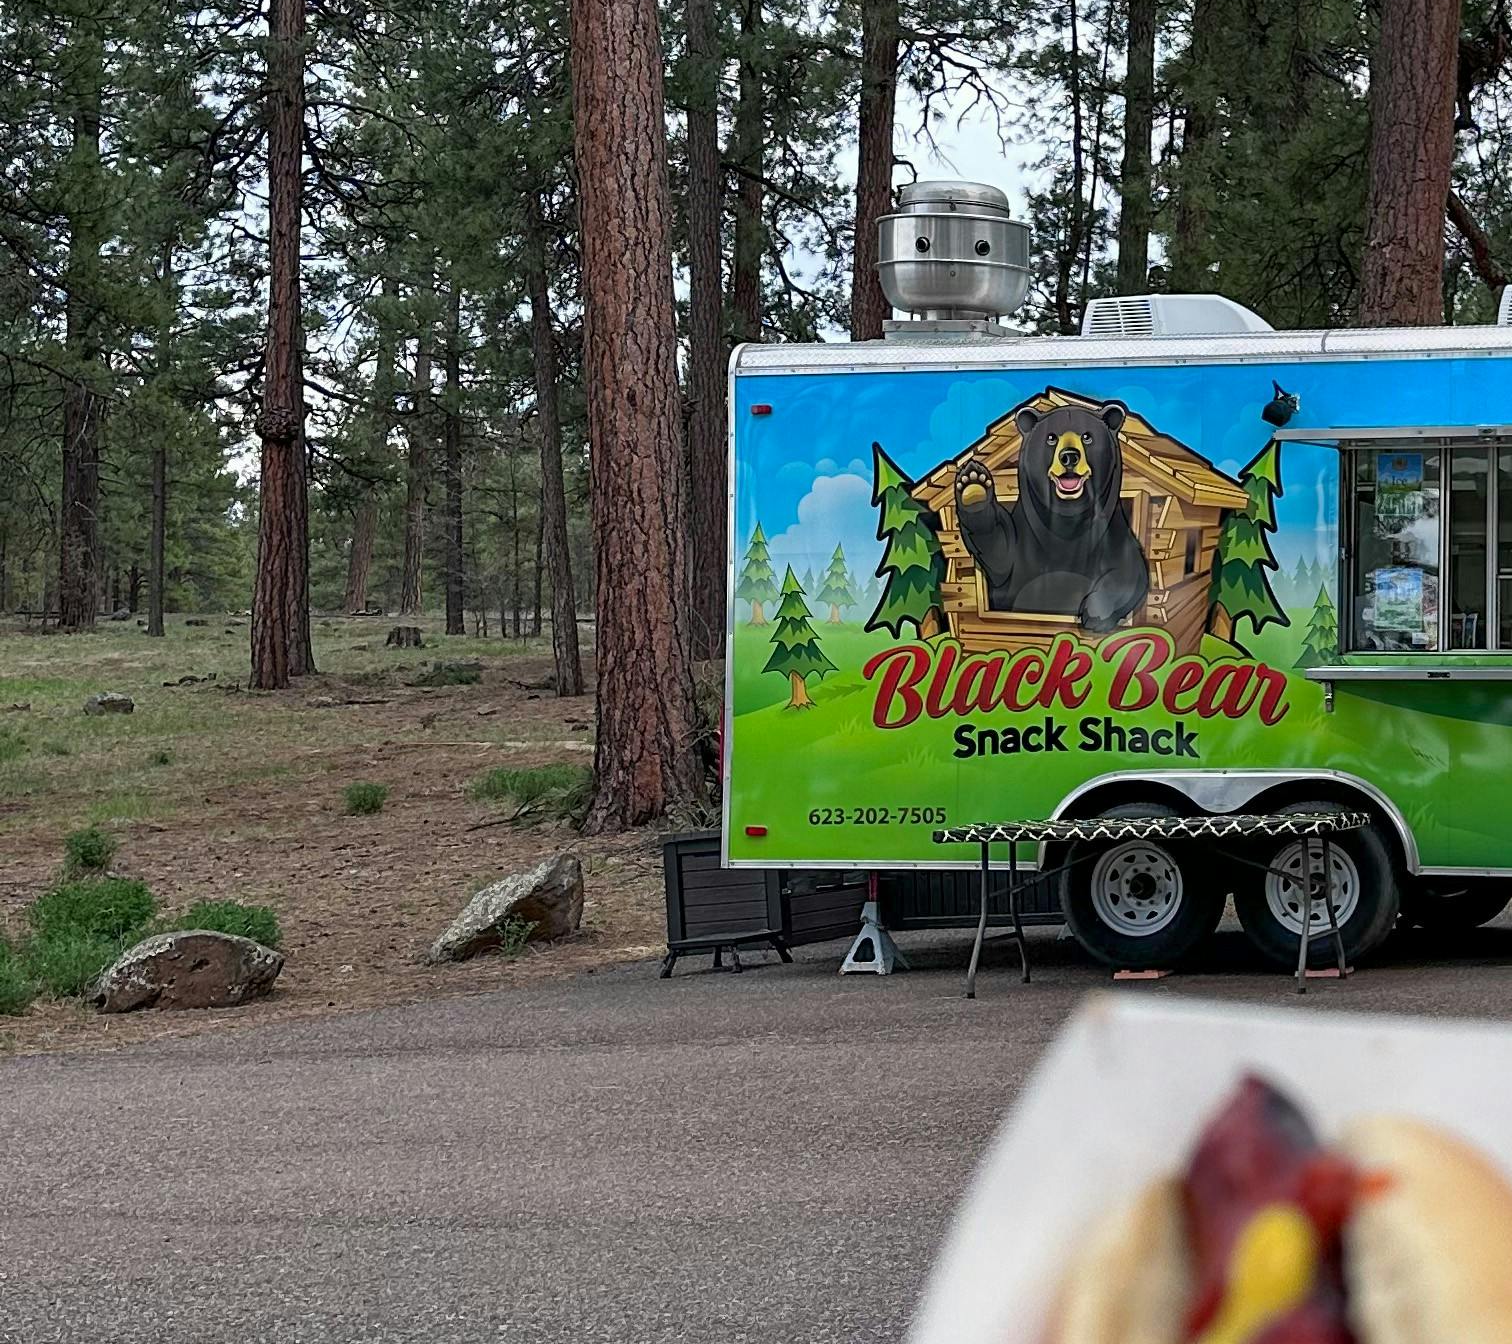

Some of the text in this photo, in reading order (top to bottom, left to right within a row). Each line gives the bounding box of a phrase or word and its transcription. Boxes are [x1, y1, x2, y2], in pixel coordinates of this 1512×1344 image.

[863, 634, 1290, 729] Black Bear
[953, 716, 1201, 759] Snack Shack
[808, 807, 947, 825] 623-202-7505
